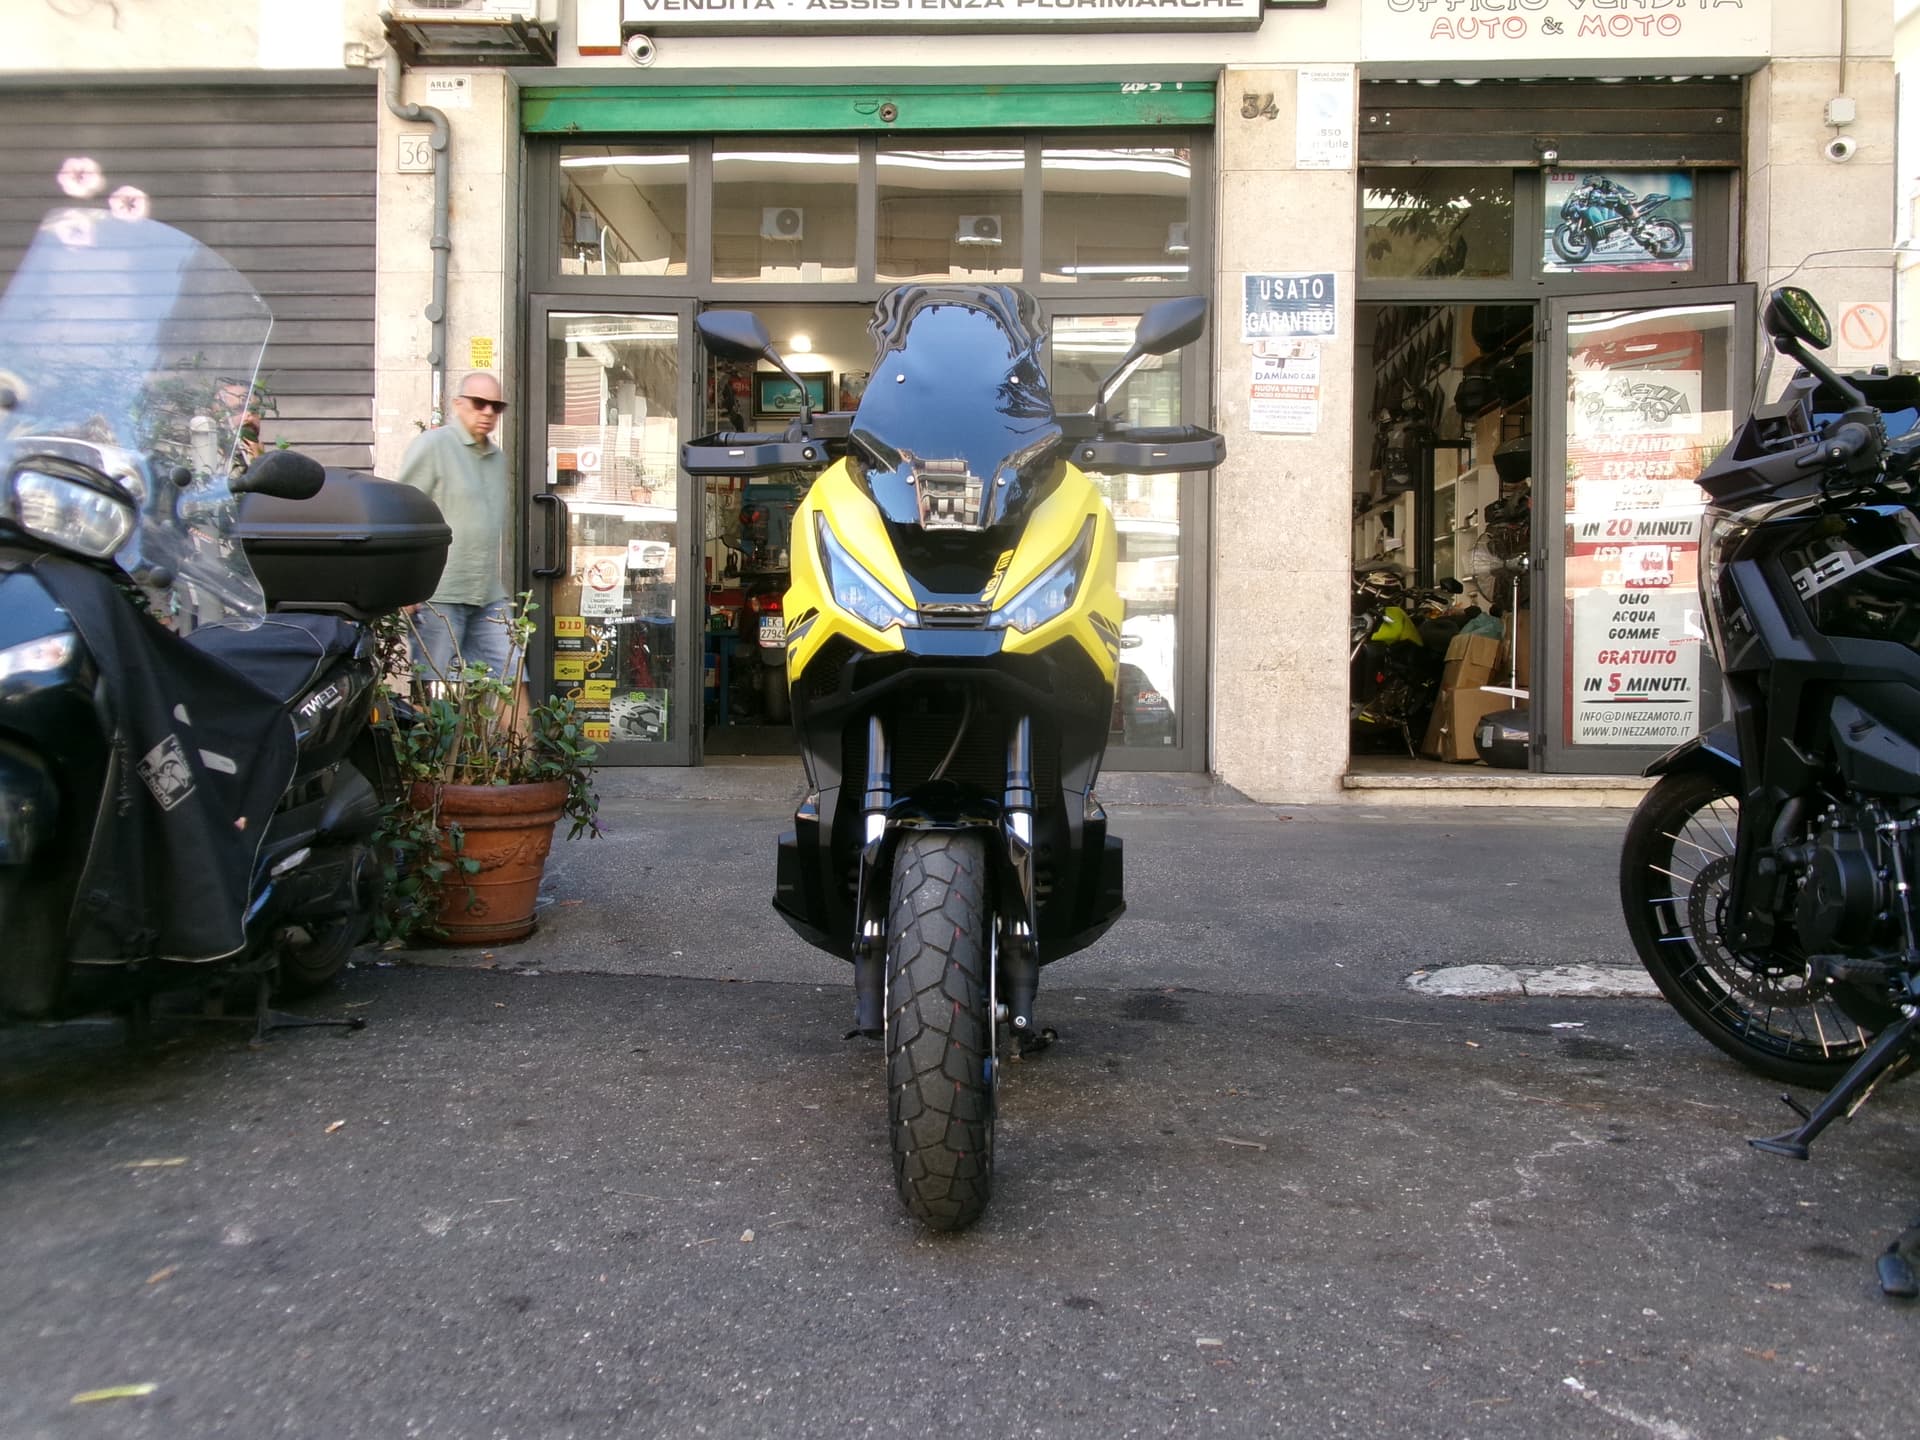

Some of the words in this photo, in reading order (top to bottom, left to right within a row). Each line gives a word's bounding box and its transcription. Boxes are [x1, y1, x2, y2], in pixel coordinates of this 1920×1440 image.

[643, 0, 775, 10] VENDITA
[806, 0, 1007, 9] ASSISTENZA
[1430, 17, 1527, 39] AUTO
[1541, 17, 1564, 35] &
[1578, 14, 1682, 37] MOTO
[1240, 93, 1280, 120] 34
[401, 141, 429, 165] 36
[1551, 173, 1575, 181] DID
[1260, 278, 1324, 300] USATO
[1247, 310, 1333, 333] GARANTITO
[1255, 372, 1299, 380] DAMIANO
[1582, 522, 1600, 536] IN
[1606, 519, 1633, 536] 20
[1636, 521, 1693, 536] MINUTI
[1619, 593, 1650, 605] OLIO
[1612, 610, 1656, 623] ACQUA
[559, 621, 582, 630] DID
[1608, 628, 1661, 639] GOMME
[1597, 650, 1677, 665] GRATUITO
[1584, 678, 1602, 691] IN
[1608, 673, 1622, 692] 5
[300, 683, 337, 717] TWEET
[1580, 711, 1693, 723] INFO@DINEZZAMOTO.IT
[1582, 726, 1691, 736] WWW.DINEZZAMOTO.IT
